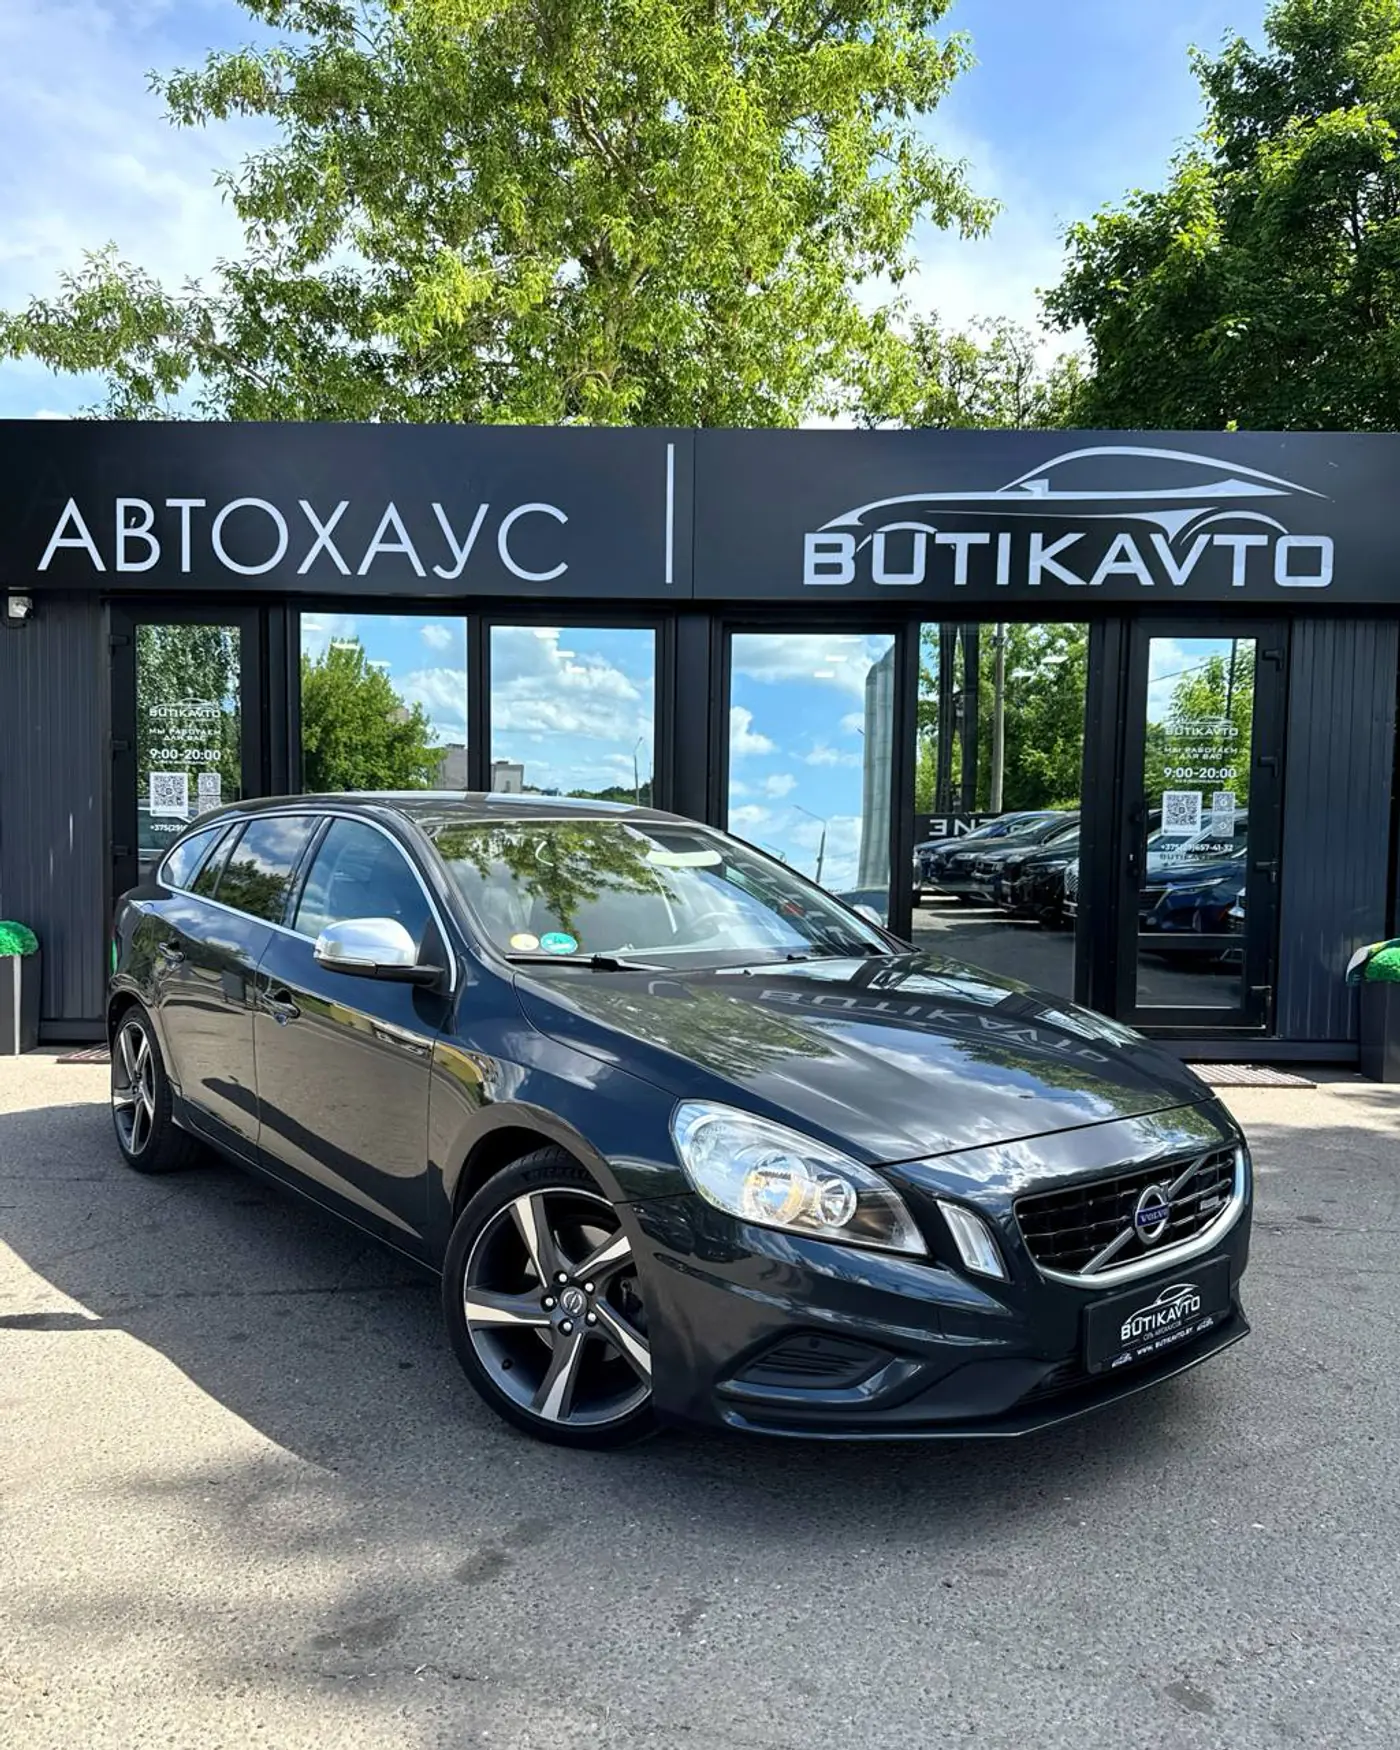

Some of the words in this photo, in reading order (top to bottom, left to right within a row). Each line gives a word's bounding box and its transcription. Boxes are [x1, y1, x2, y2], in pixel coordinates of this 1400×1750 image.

[36, 496, 569, 582] АВТОХАУС
[802, 531, 1334, 588] BUTIKAVTO
[149, 748, 222, 760] 9:00-20:00
[1163, 767, 1237, 779] 9:00-20:00
[1140, 1209, 1168, 1222] VOLVO
[1121, 1295, 1201, 1341] BUTIKAVTO
